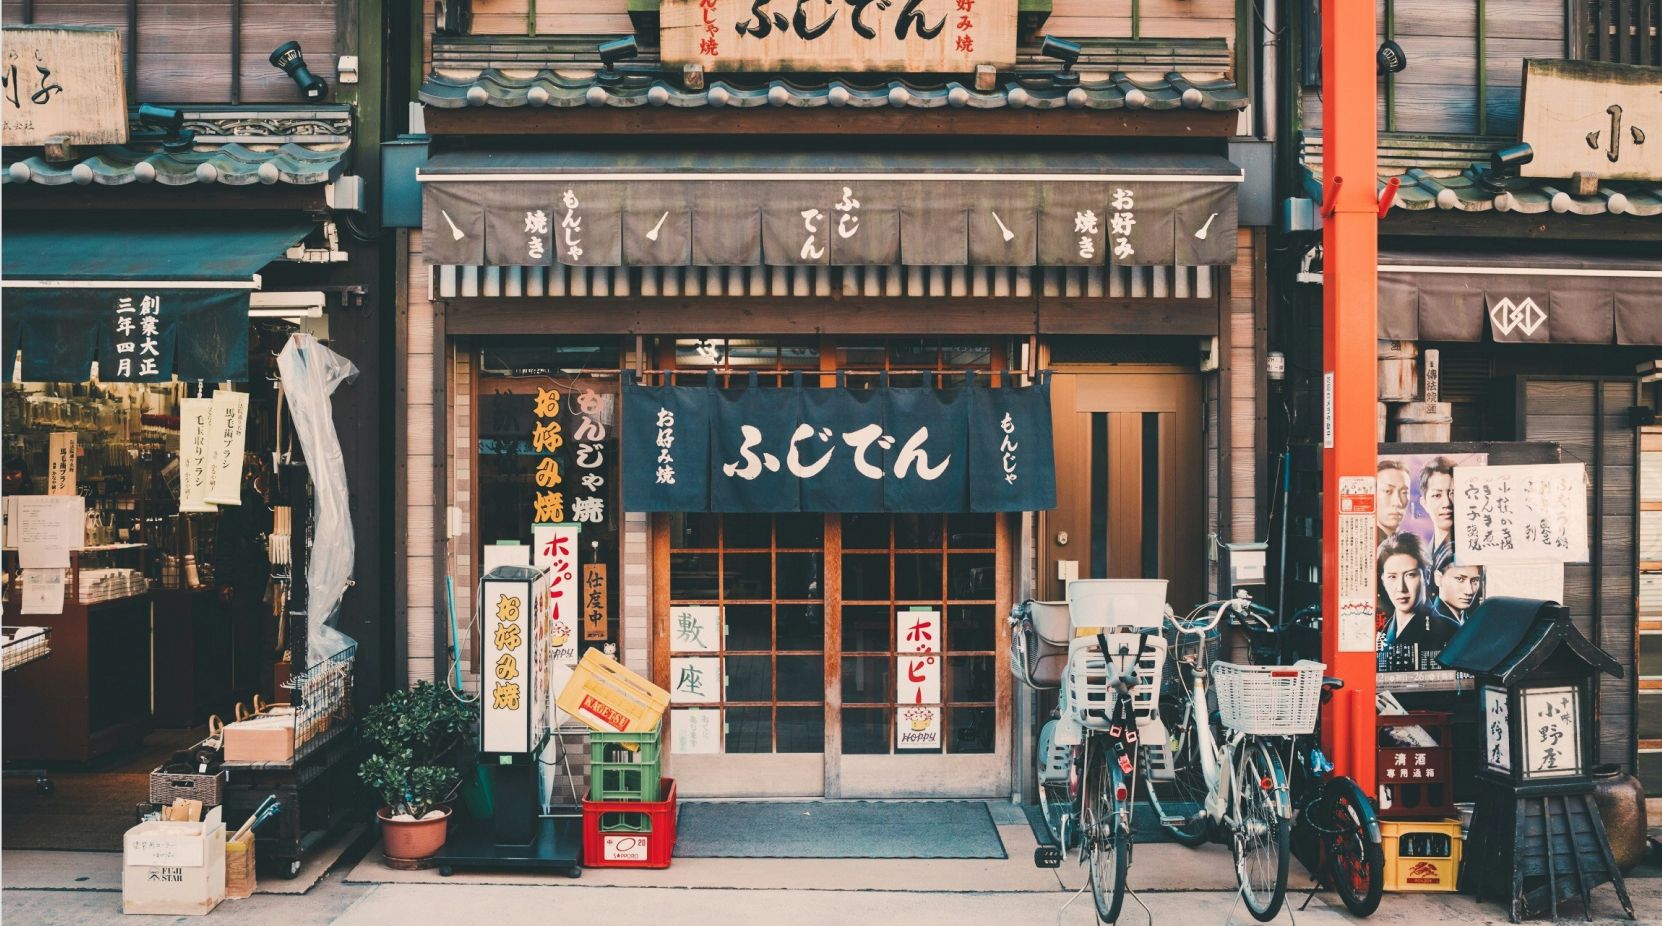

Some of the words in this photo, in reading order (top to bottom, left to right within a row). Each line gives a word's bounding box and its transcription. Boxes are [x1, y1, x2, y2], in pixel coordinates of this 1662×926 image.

[735, 0, 948, 41] ふじでん
[1585, 104, 1646, 163] 小
[524, 209, 549, 259] 焼き
[561, 189, 584, 261] もんじゃ
[800, 208, 826, 260] でん
[834, 186, 861, 239] ふじ
[1074, 209, 1098, 259] 焼き
[1110, 188, 1137, 260] お好み
[115, 297, 137, 378] 三年四月
[138, 294, 161, 377] 創業大正
[531, 387, 564, 523] お好み焼
[572, 387, 606, 523] もんじゃ焼
[655, 407, 677, 486] お好み焼
[722, 422, 952, 481] ふじでん
[1000, 411, 1019, 486] もんじゃ
[586, 570, 604, 628] 仕度中
[493, 593, 522, 711] お好み焼
[677, 611, 708, 649] 敷
[676, 664, 706, 698] 座
[906, 616, 935, 704] ホッピー
[901, 731, 937, 744] HOPPY
[1394, 752, 1427, 767] 清酒
[1537, 701, 1564, 771] 小野屋
[161, 867, 183, 875] FUJI
[637, 838, 646, 847] 20
[161, 874, 183, 882] STAR
